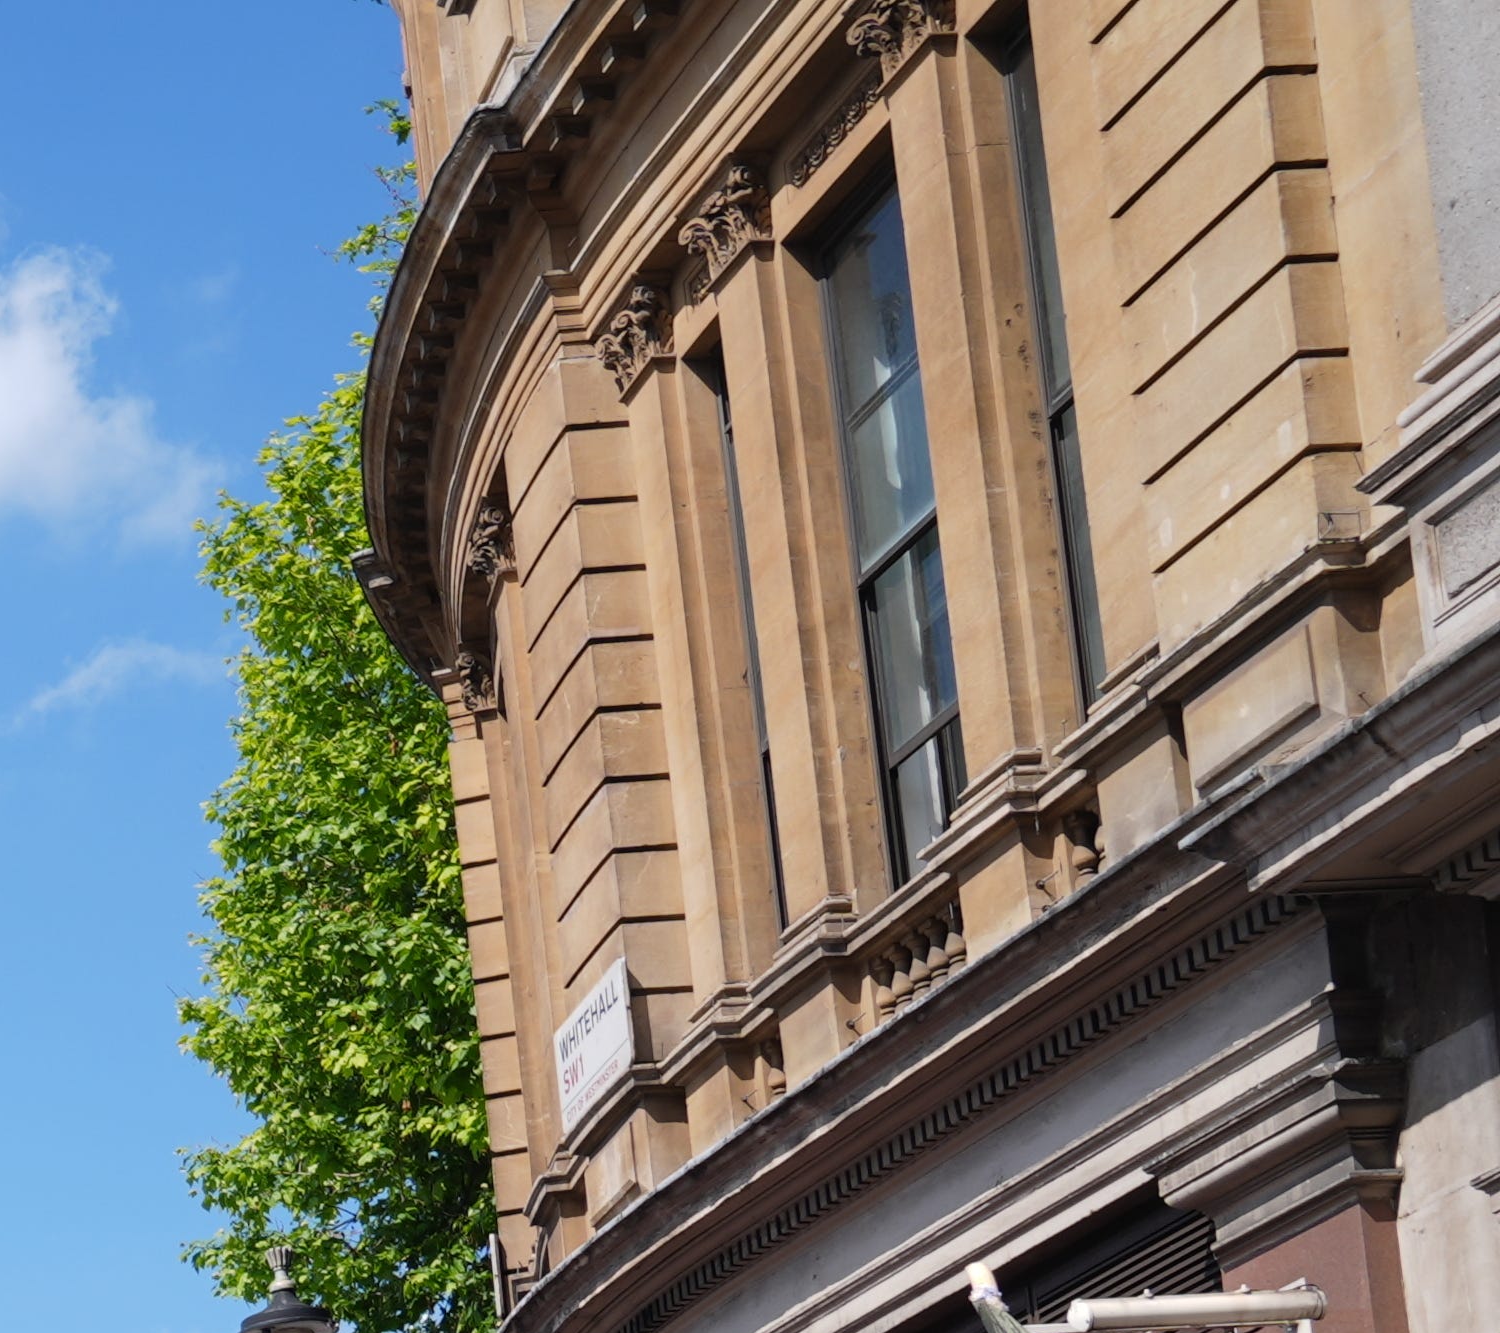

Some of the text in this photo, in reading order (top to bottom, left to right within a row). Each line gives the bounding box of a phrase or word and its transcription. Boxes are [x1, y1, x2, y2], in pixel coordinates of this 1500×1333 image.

[559, 980, 618, 1062] WHITEHALL
[563, 1053, 585, 1094] SW1
[585, 1059, 619, 1102] WESTMINSTER
